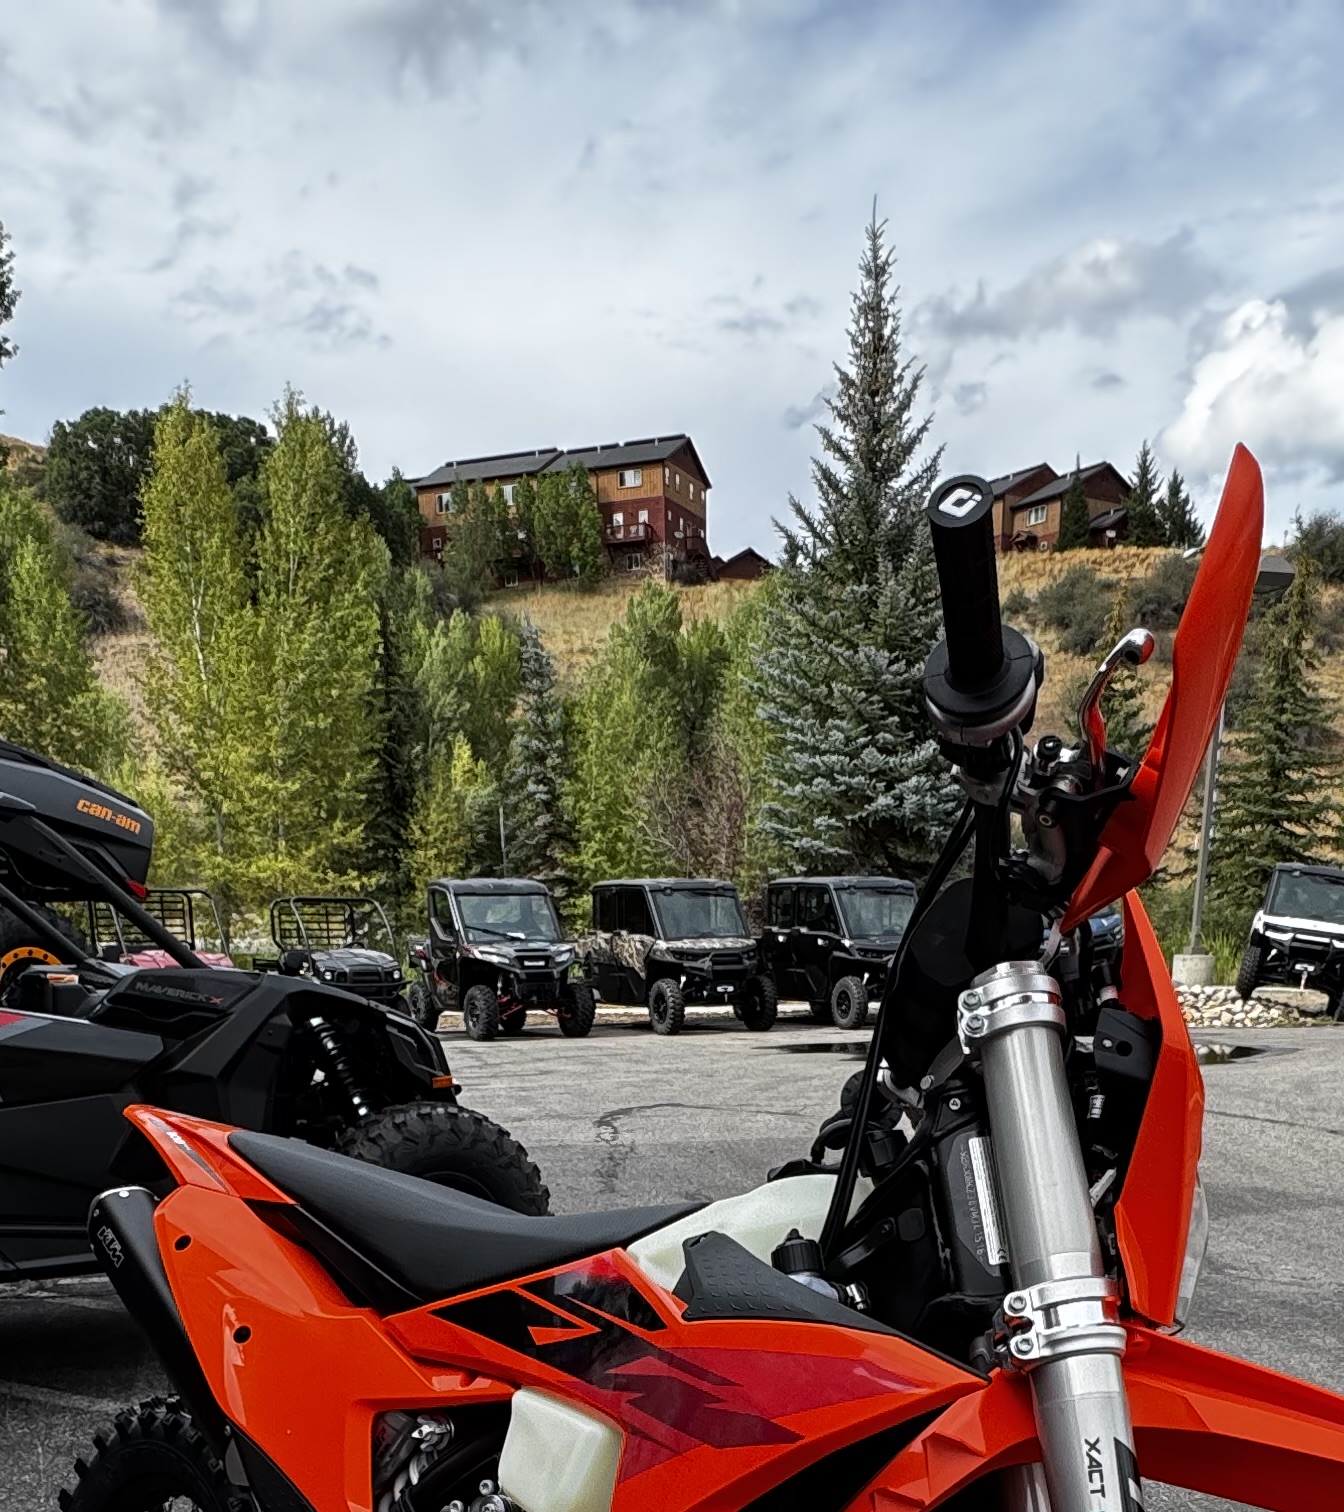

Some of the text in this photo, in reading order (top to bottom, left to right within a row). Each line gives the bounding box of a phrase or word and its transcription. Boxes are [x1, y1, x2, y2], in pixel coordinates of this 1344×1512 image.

[76, 799, 141, 834] can-am
[135, 982, 207, 1002] MAVERICK
[97, 1225, 124, 1268] KTM
[1084, 1436, 1106, 1499] XACT
